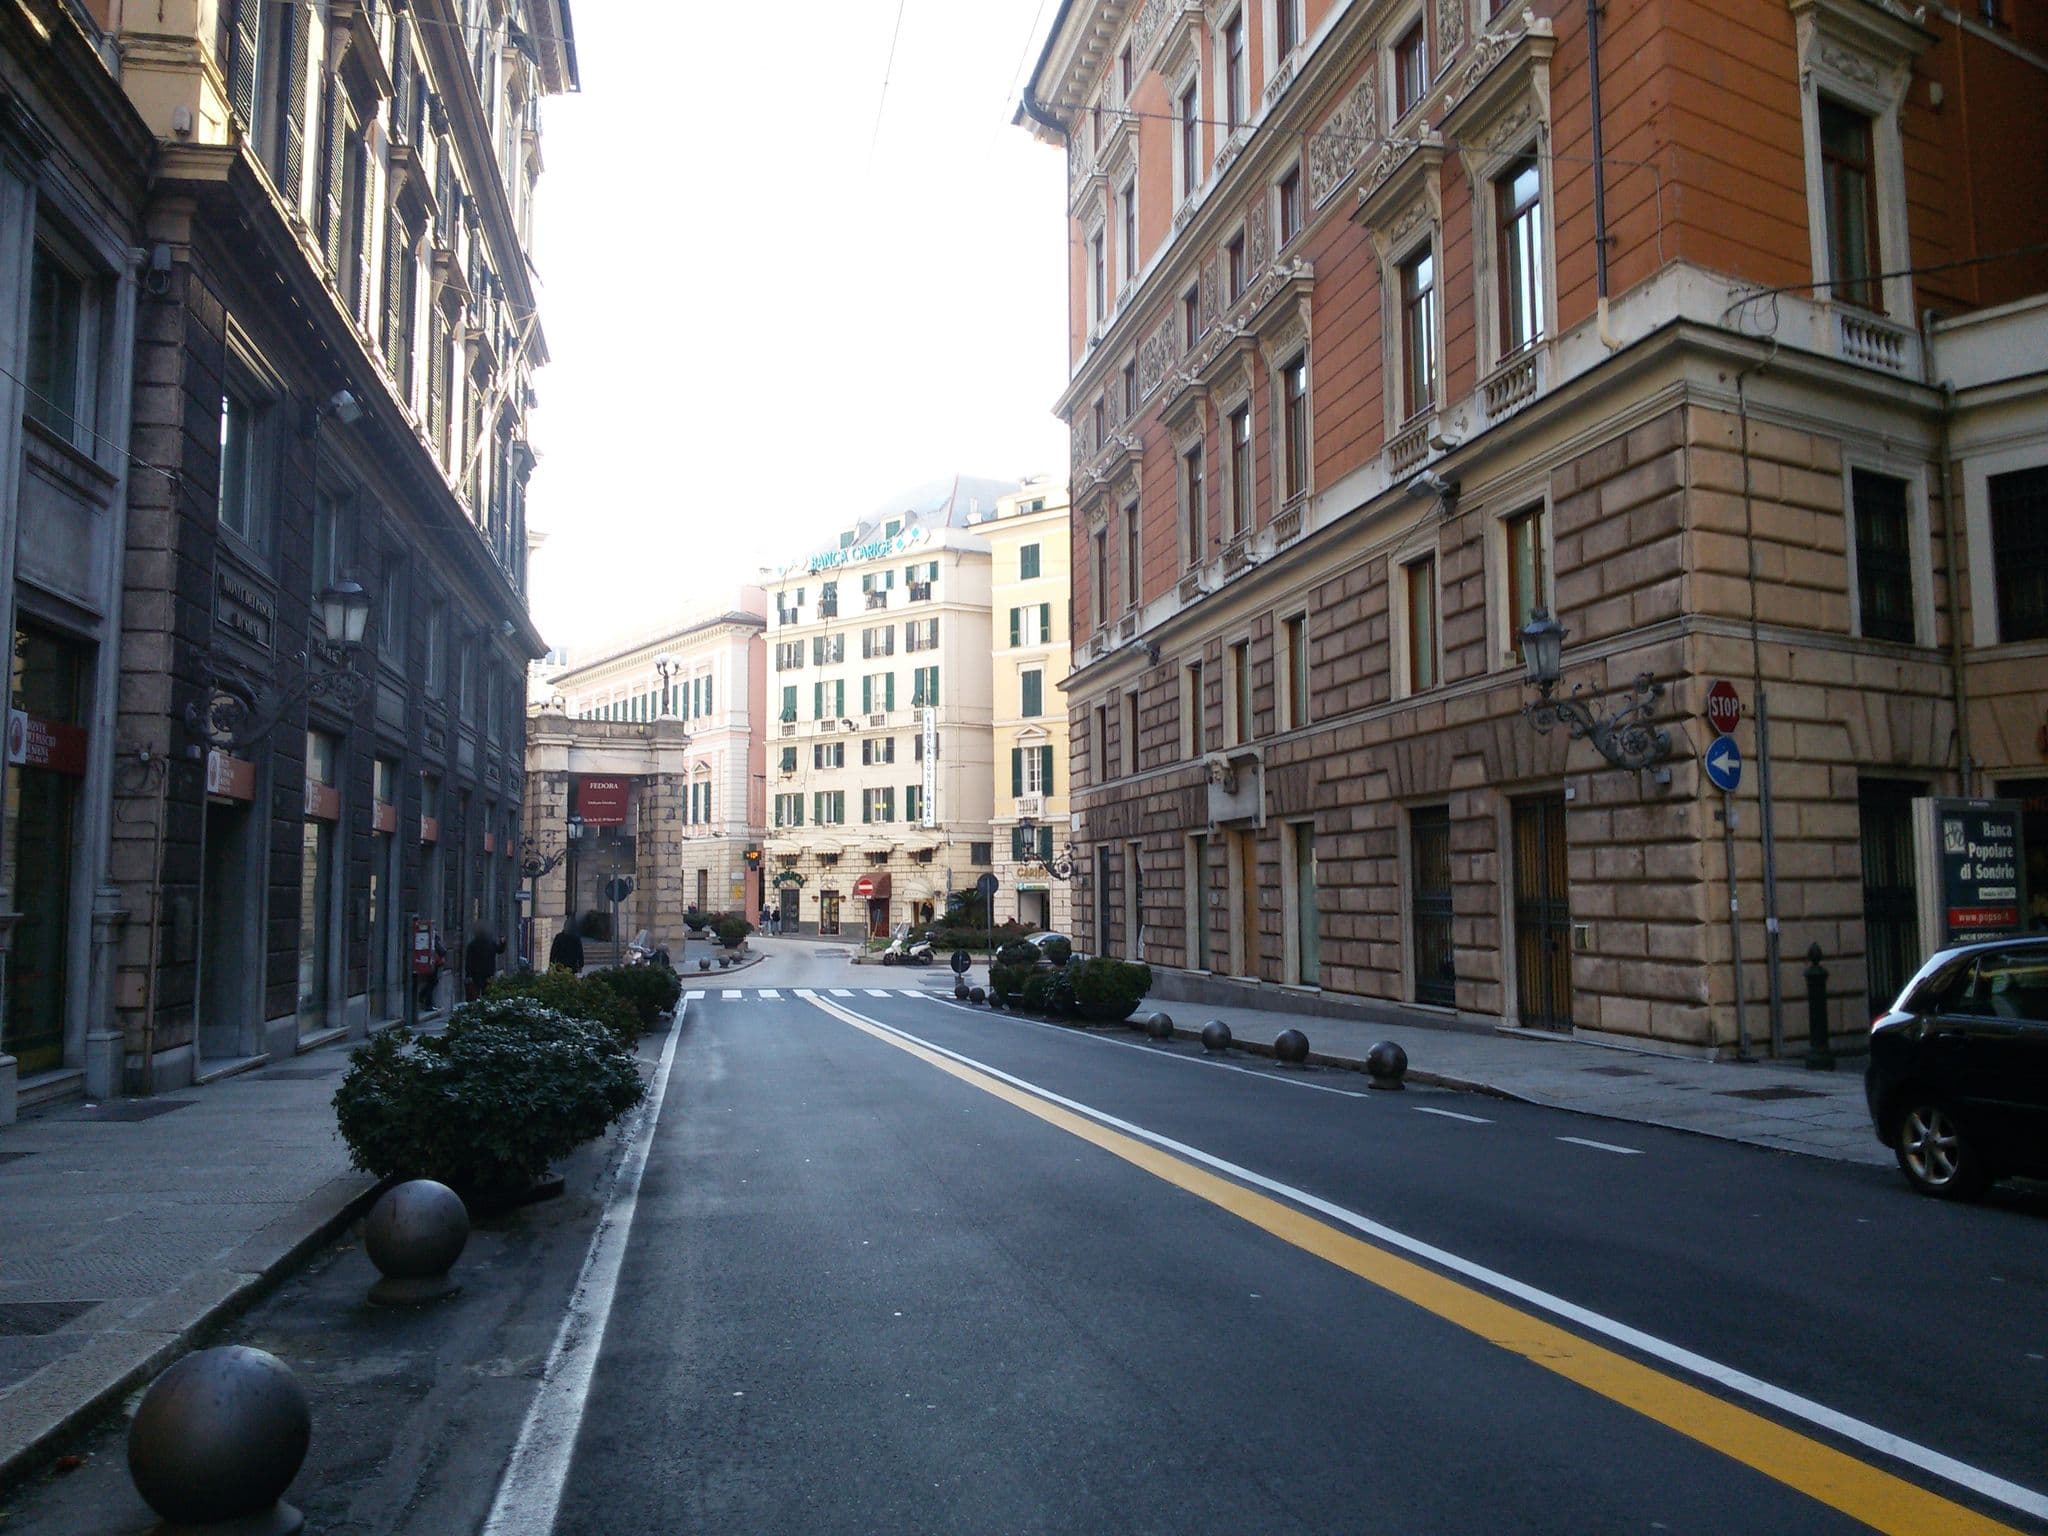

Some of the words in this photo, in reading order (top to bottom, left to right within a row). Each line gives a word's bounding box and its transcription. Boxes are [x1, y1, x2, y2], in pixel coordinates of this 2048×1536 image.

[811, 548, 848, 569] BANCA
[852, 540, 892, 561] CARIGE
[1711, 696, 1738, 717] STOP
[1982, 821, 2012, 837] Banca
[1968, 842, 2014, 861] Popolare
[1960, 863, 1971, 880] di
[1976, 863, 2015, 880] Sondrio
